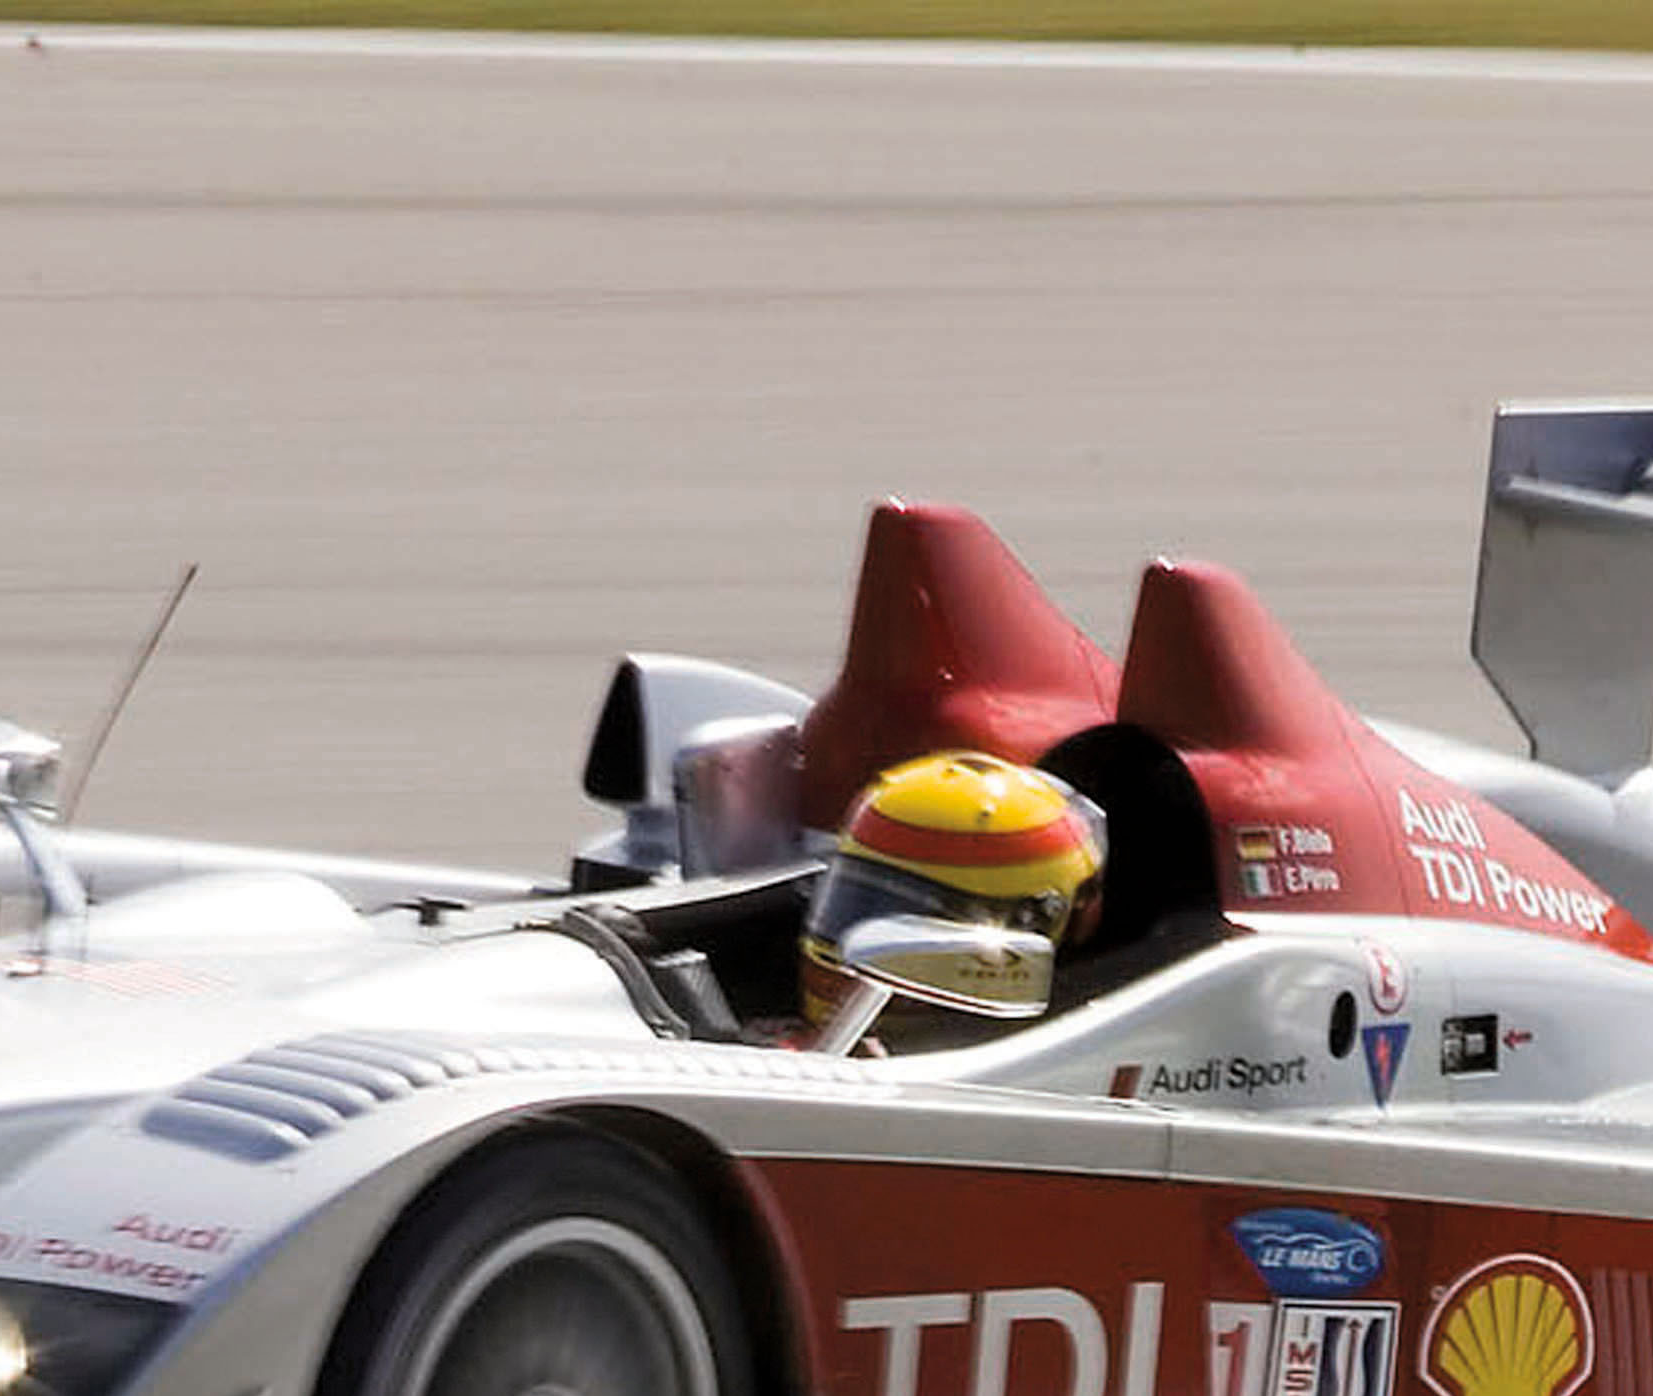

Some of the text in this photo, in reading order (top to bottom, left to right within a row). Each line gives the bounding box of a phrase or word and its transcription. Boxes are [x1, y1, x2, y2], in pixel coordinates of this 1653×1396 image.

[1398, 788, 1486, 851] Audi
[1408, 843, 1612, 934] TDI Power
[1148, 1056, 1307, 1096] Audi Sport
[111, 1213, 232, 1253] Audi
[32, 1236, 208, 1290] Power
[1260, 1249, 1286, 1268] LE
